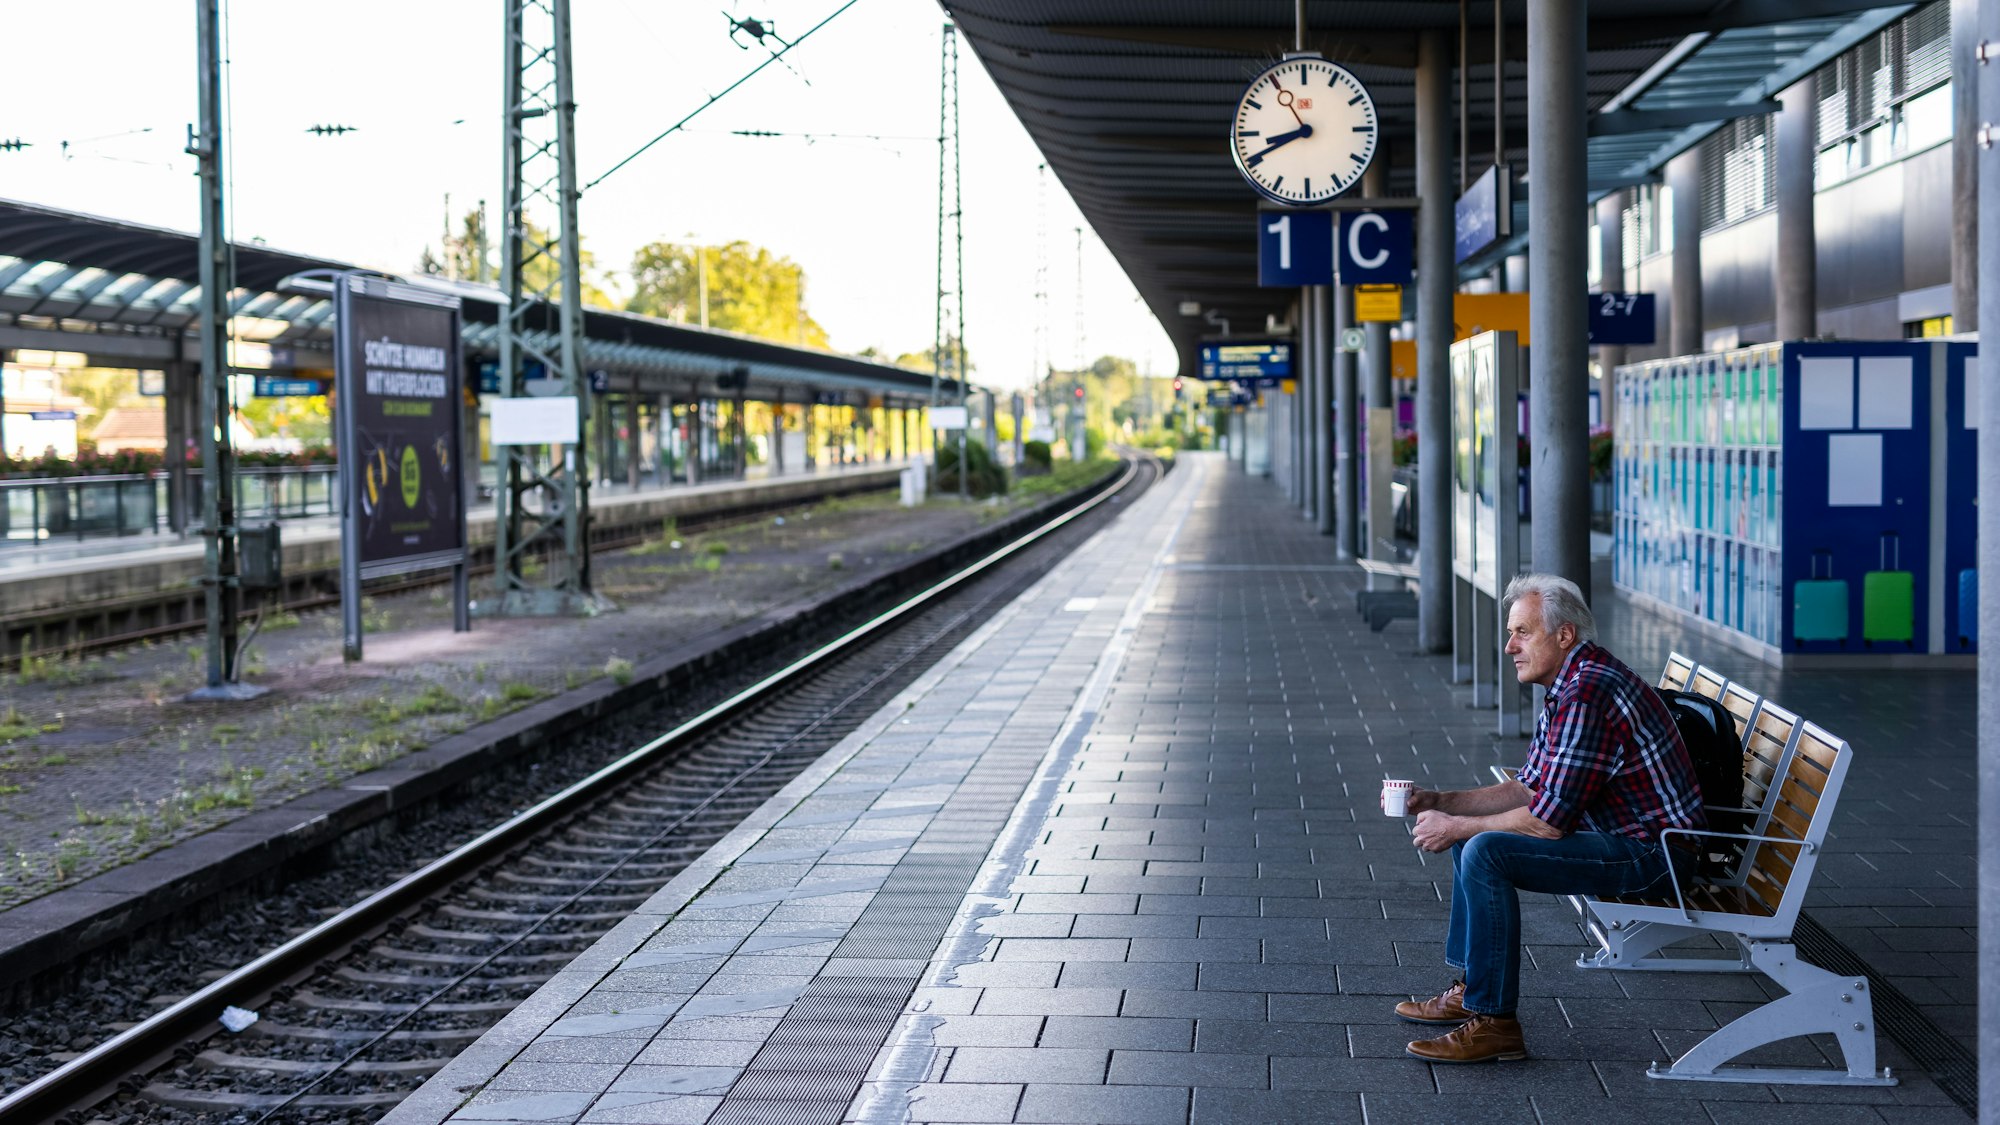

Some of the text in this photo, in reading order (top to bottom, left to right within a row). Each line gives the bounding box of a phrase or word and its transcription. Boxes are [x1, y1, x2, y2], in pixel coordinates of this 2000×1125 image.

[1267, 215, 1291, 270] 1
[1348, 213, 1390, 269] C
[1601, 293, 1638, 316] 2-7
[365, 336, 446, 371] SCHÜTZE HUMMELN
[366, 370, 382, 395] MIT
